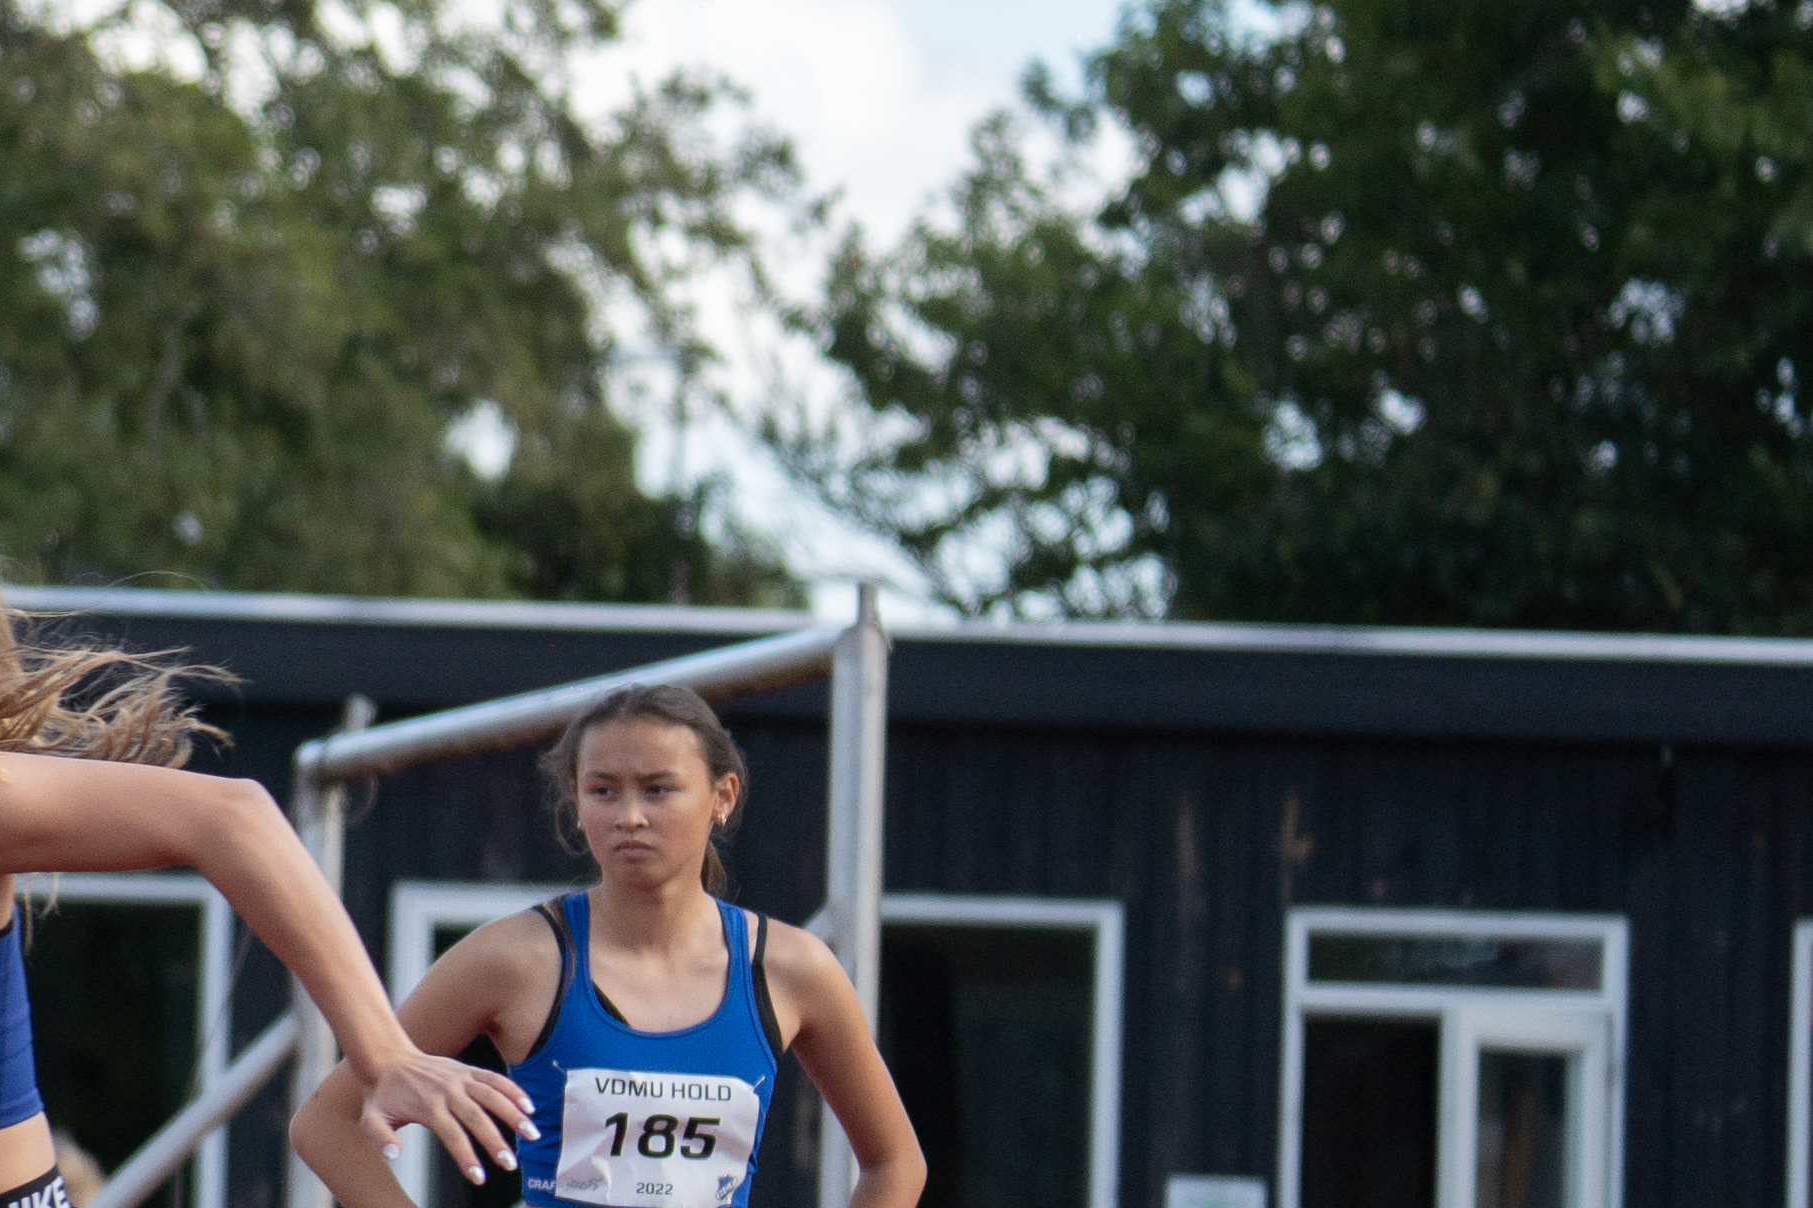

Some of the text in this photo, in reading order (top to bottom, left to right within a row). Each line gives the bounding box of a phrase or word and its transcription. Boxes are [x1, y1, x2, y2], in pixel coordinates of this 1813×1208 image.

[594, 1077, 733, 1102] VDMU HOLD
[605, 1112, 721, 1161] 185
[636, 1182, 674, 1196] 2022
